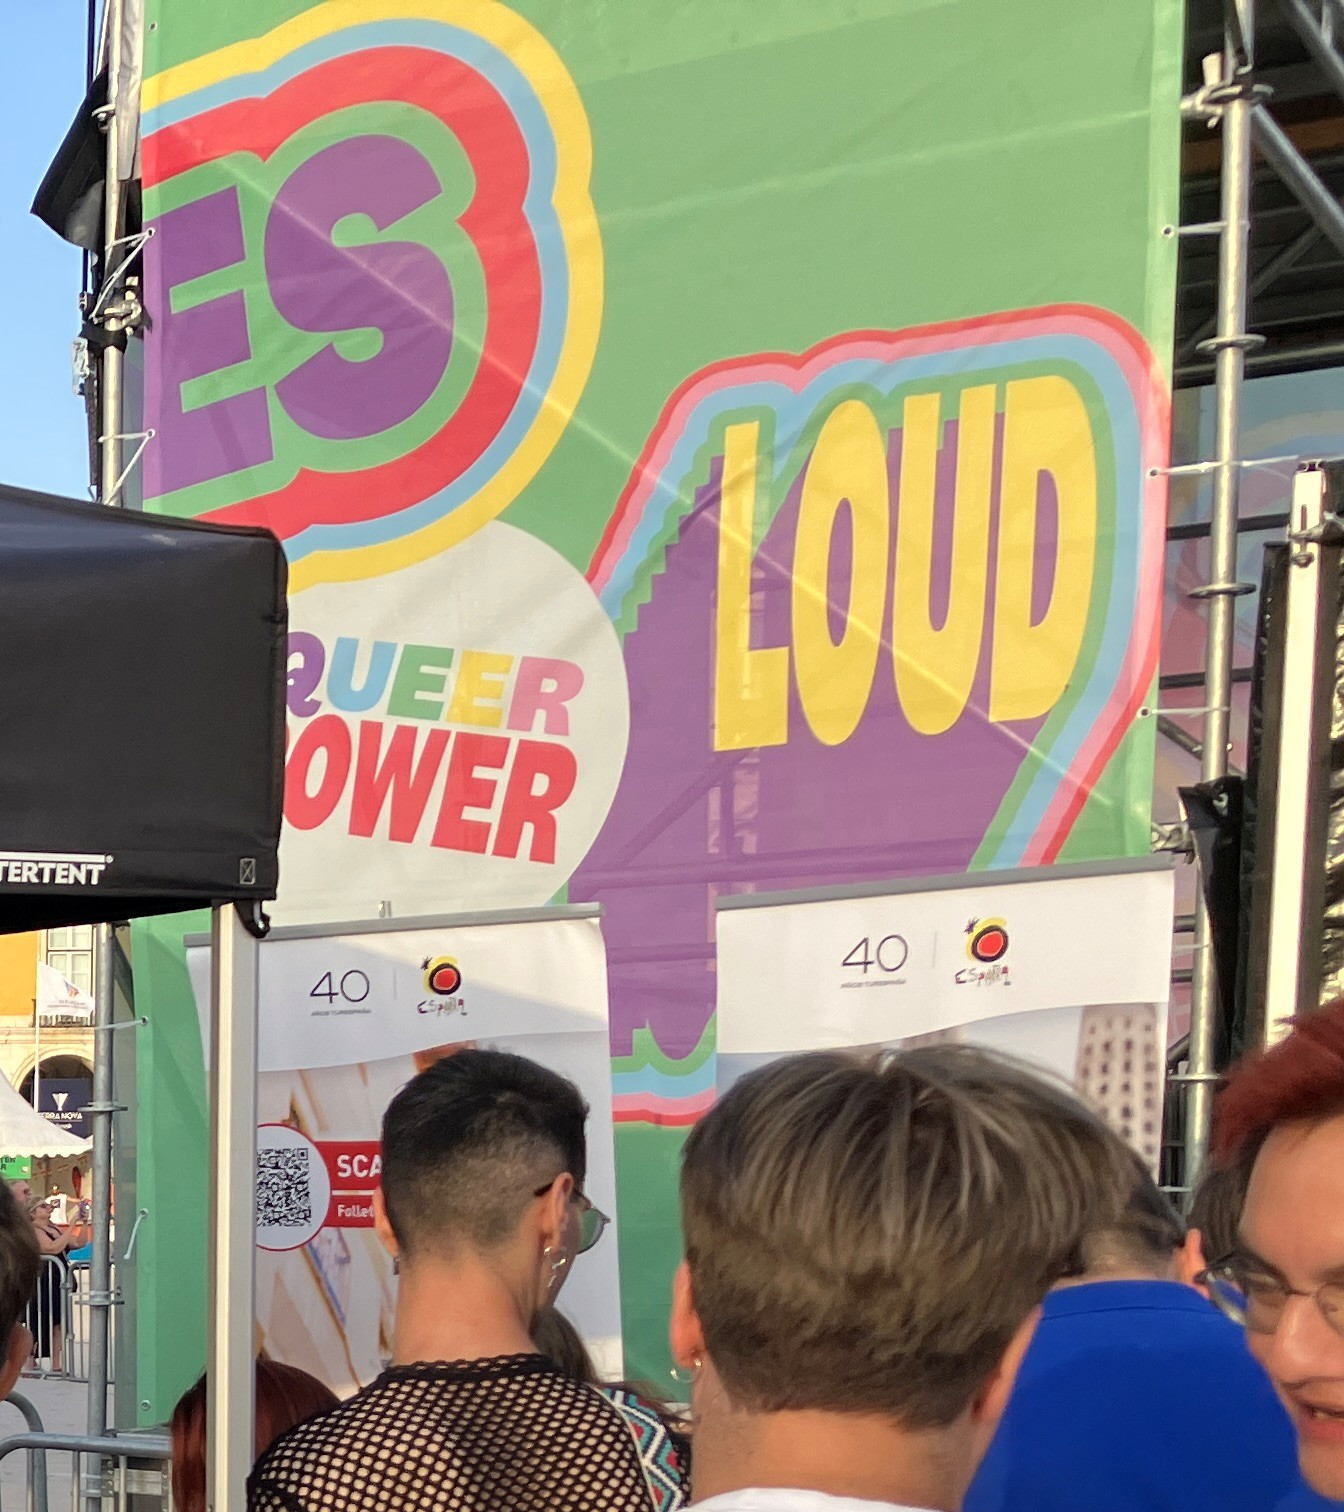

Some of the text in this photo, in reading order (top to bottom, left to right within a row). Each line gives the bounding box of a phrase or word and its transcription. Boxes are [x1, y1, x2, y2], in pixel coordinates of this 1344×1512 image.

[714, 376, 1098, 752] LOUD
[286, 631, 585, 737] QUEER
[283, 714, 578, 865] OWER
[309, 969, 370, 1004] 40
[841, 934, 909, 974] 40
